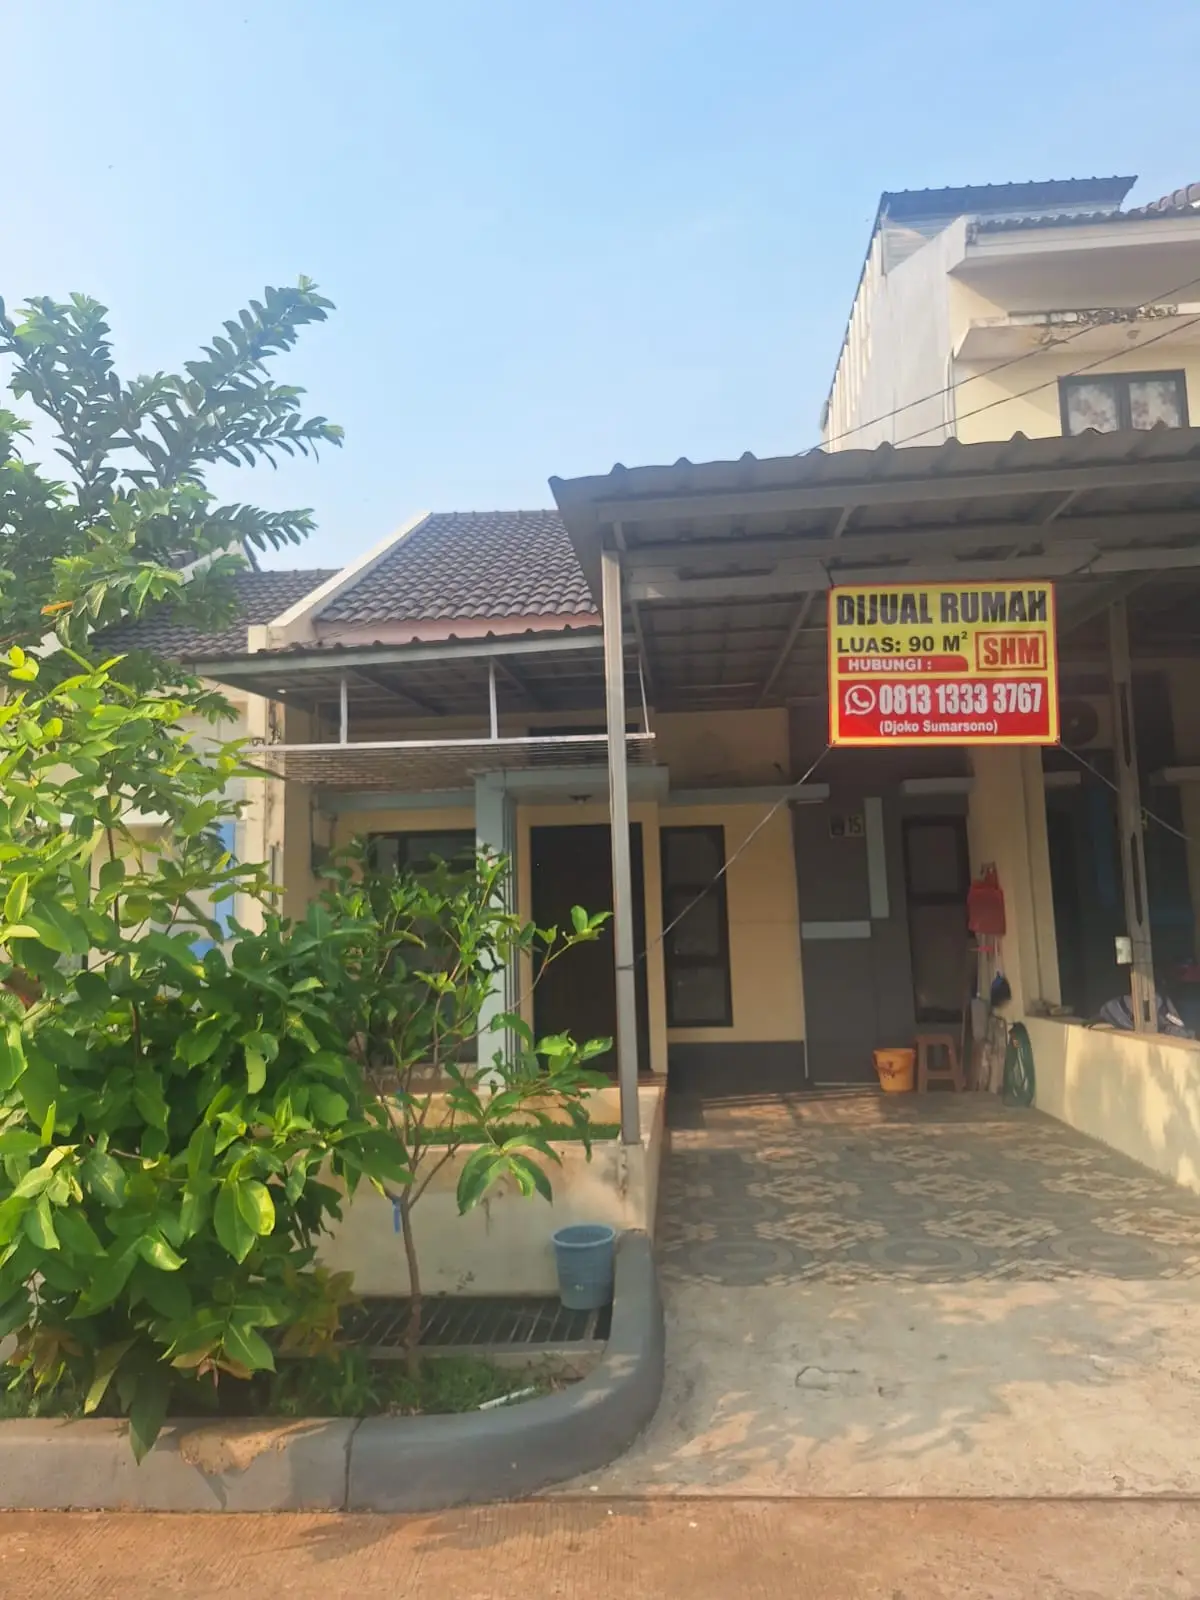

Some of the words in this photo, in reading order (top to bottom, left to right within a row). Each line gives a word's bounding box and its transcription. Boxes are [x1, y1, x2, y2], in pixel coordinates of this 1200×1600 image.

[837, 593, 933, 625] DIJUAL
[940, 590, 1047, 623] RUMAH
[837, 637, 901, 653] LUAS:
[909, 636, 934, 652] 90
[984, 637, 1039, 665] SHM
[879, 684, 931, 715] 0813
[935, 683, 988, 714] 1333
[993, 683, 1042, 713] 3767
[880, 720, 919, 735] (Djoko
[923, 720, 998, 734] Sumarsono)
